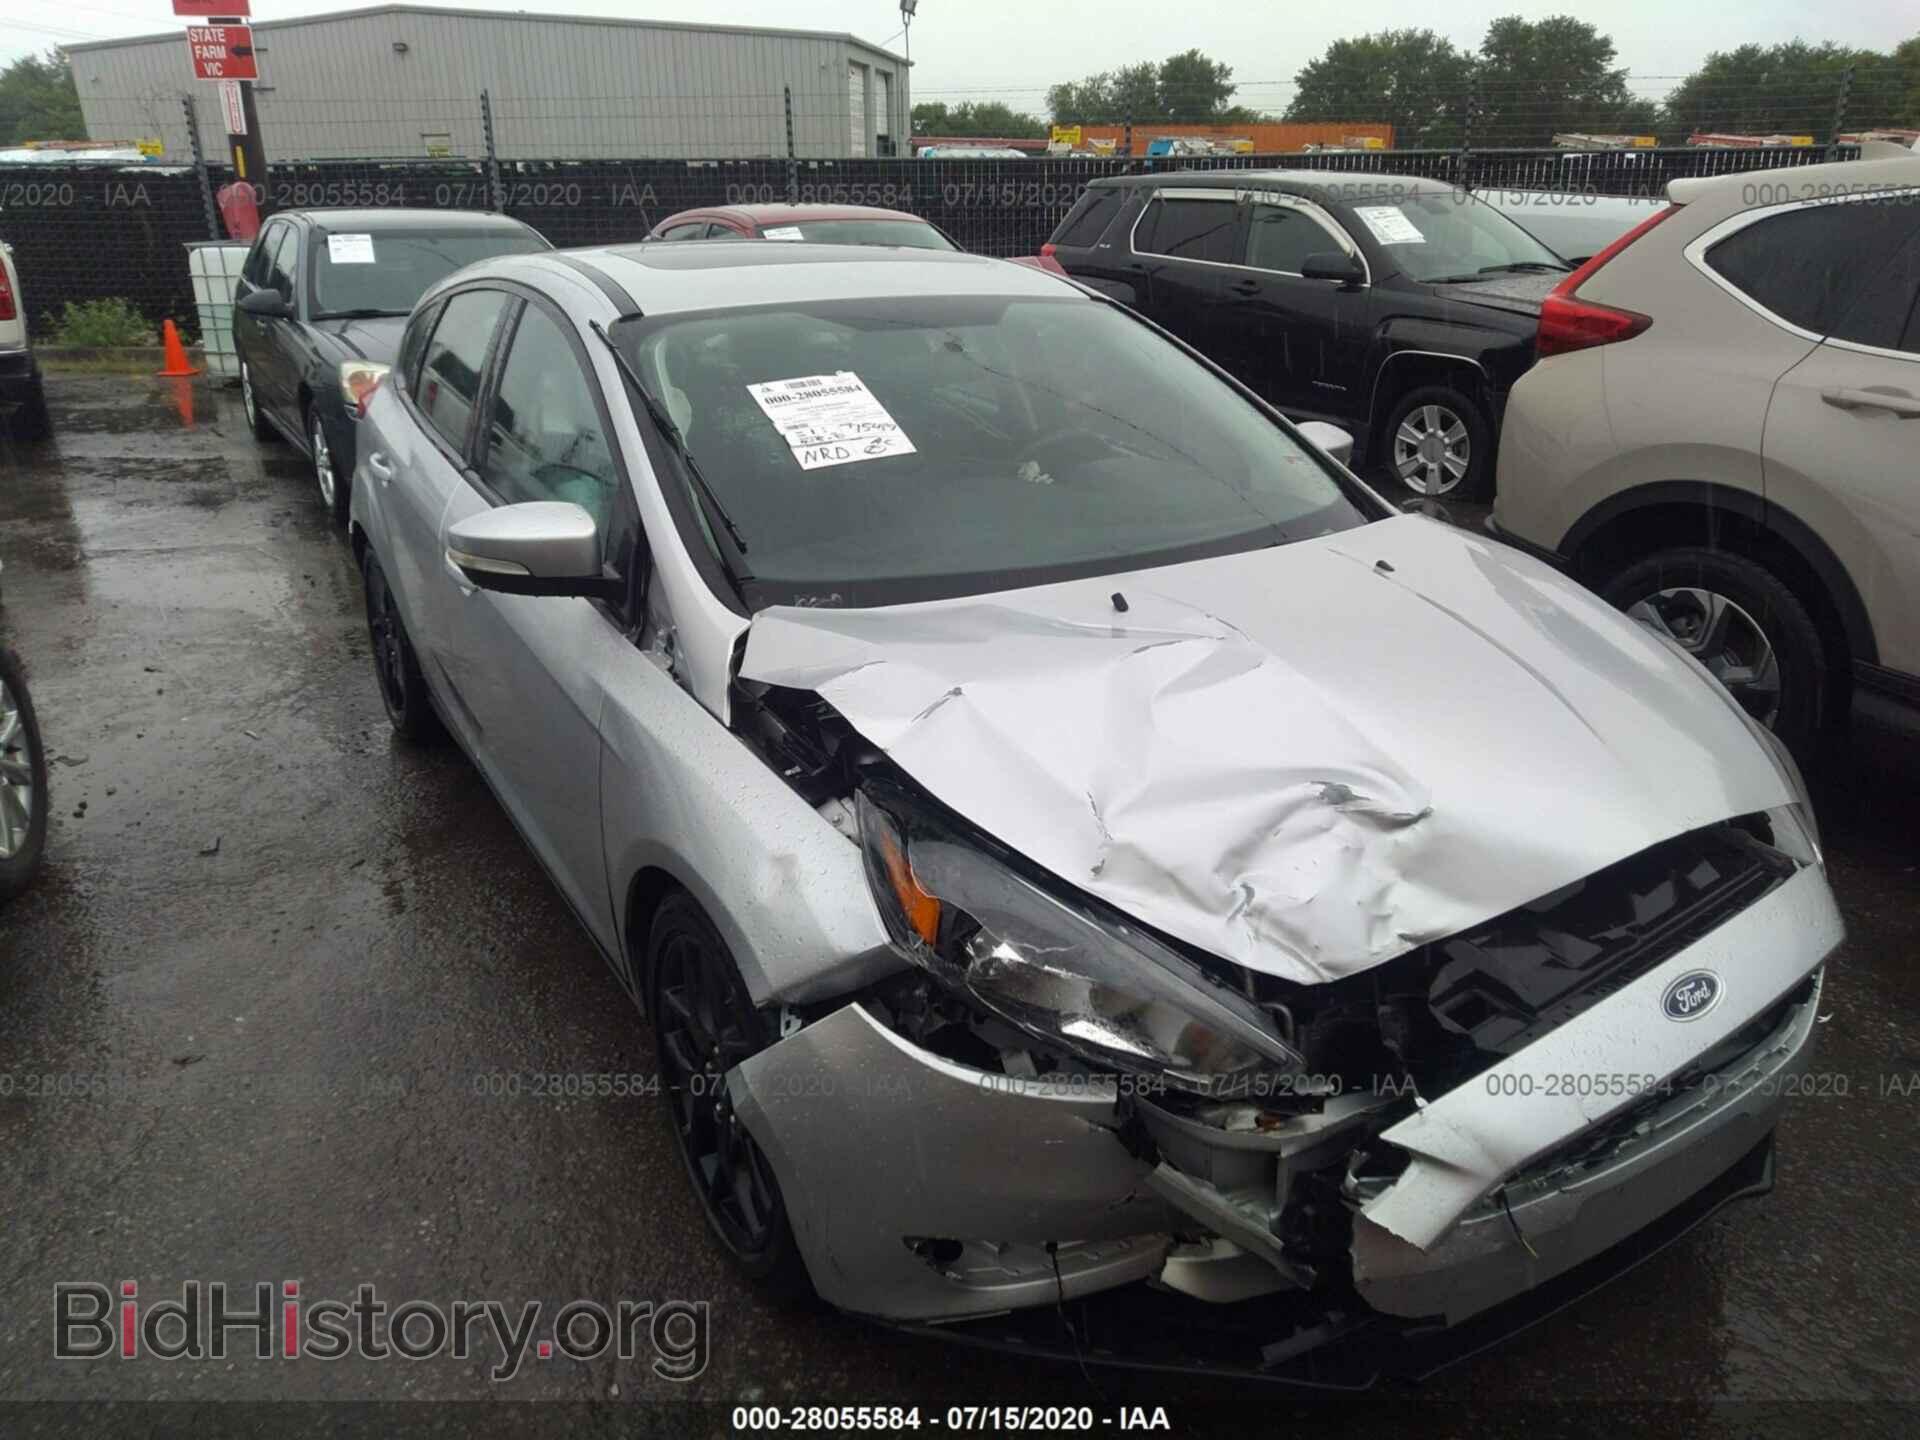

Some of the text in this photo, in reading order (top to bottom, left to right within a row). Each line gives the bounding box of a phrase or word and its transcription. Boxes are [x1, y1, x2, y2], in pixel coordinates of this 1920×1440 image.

[190, 28, 226, 42] STATE
[194, 45, 227, 59] FARM
[204, 62, 223, 76] VIC
[804, 446, 850, 464] NRD
[1676, 980, 1711, 1012] Ford
